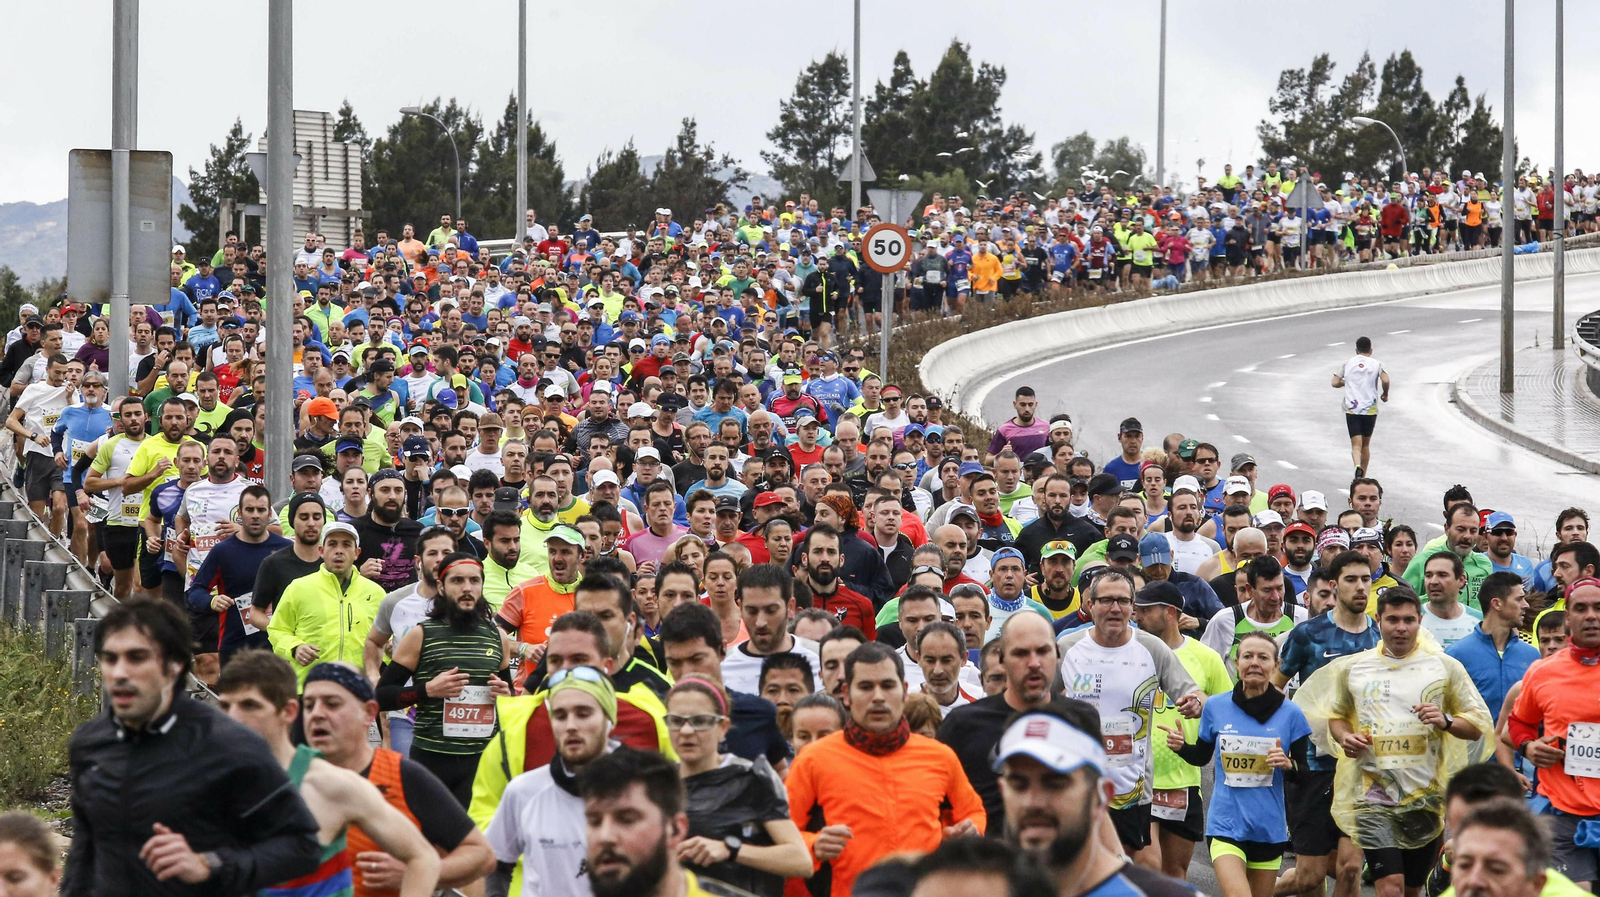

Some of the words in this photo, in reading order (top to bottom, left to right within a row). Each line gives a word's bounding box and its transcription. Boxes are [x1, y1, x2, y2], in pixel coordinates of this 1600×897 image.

[874, 239, 902, 257] 50
[448, 707, 480, 720] 4977
[1379, 739, 1410, 751] 7714
[1225, 757, 1256, 769] 7037
